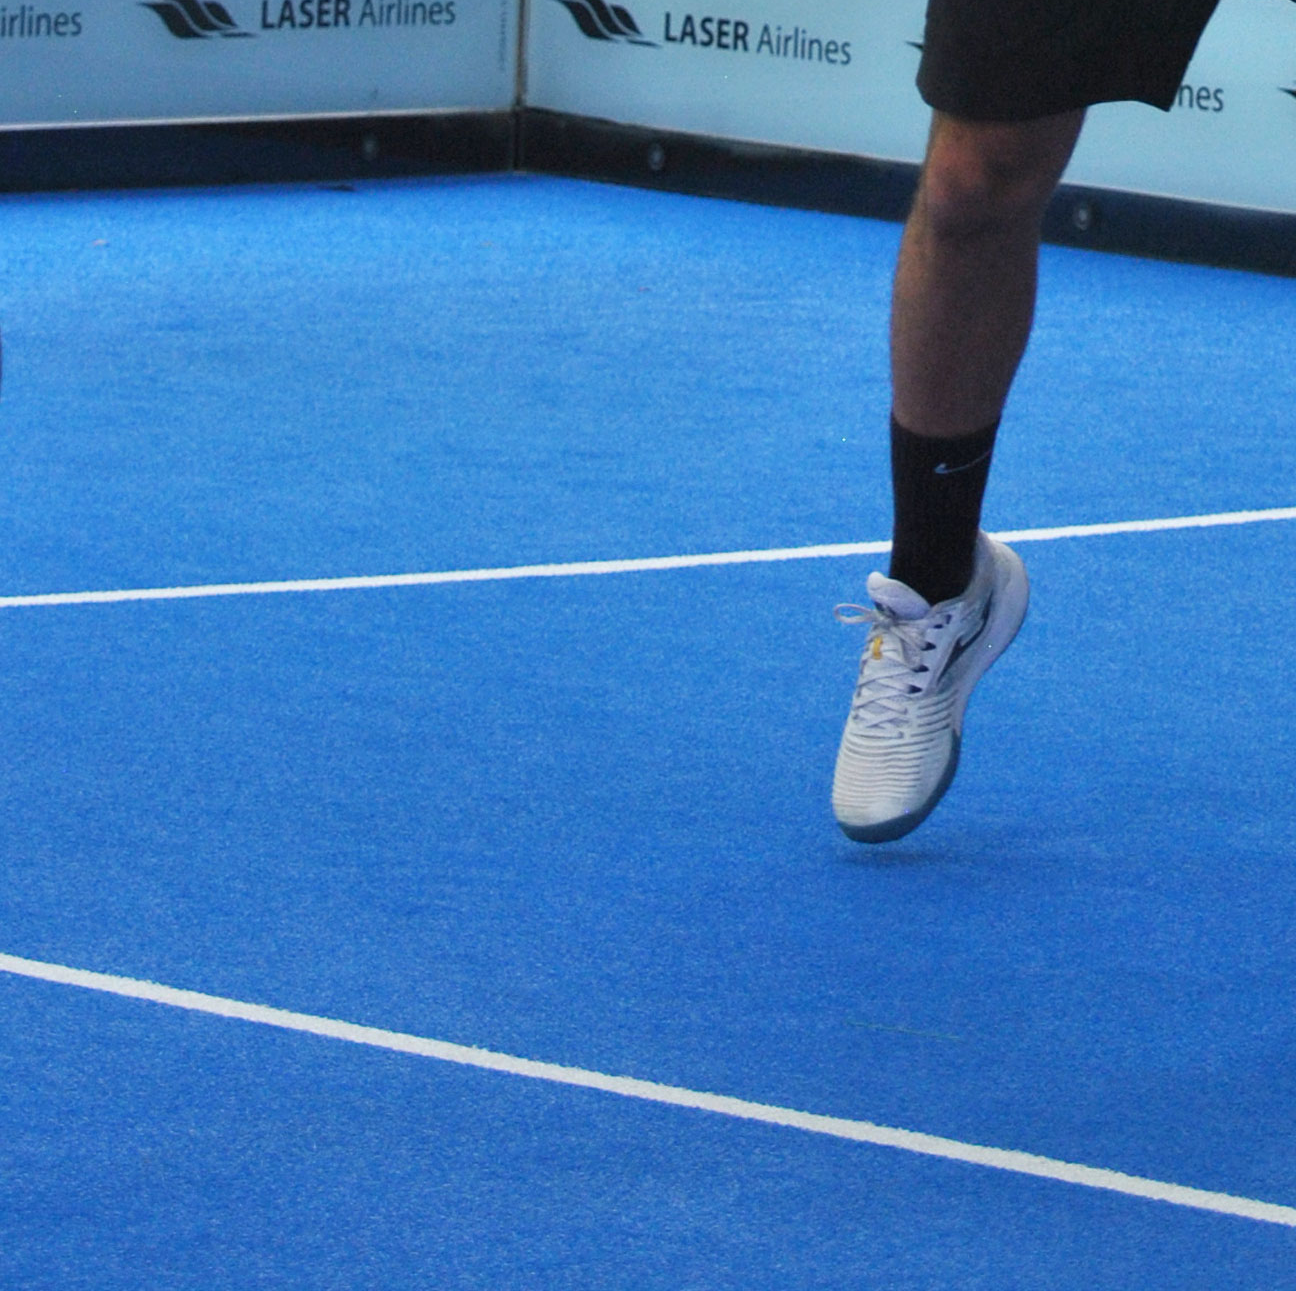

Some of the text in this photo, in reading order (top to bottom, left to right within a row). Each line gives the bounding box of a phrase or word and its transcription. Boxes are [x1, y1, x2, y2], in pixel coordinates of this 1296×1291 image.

[0, 4, 82, 38] irlines
[663, 12, 852, 67] LASER Airlines
